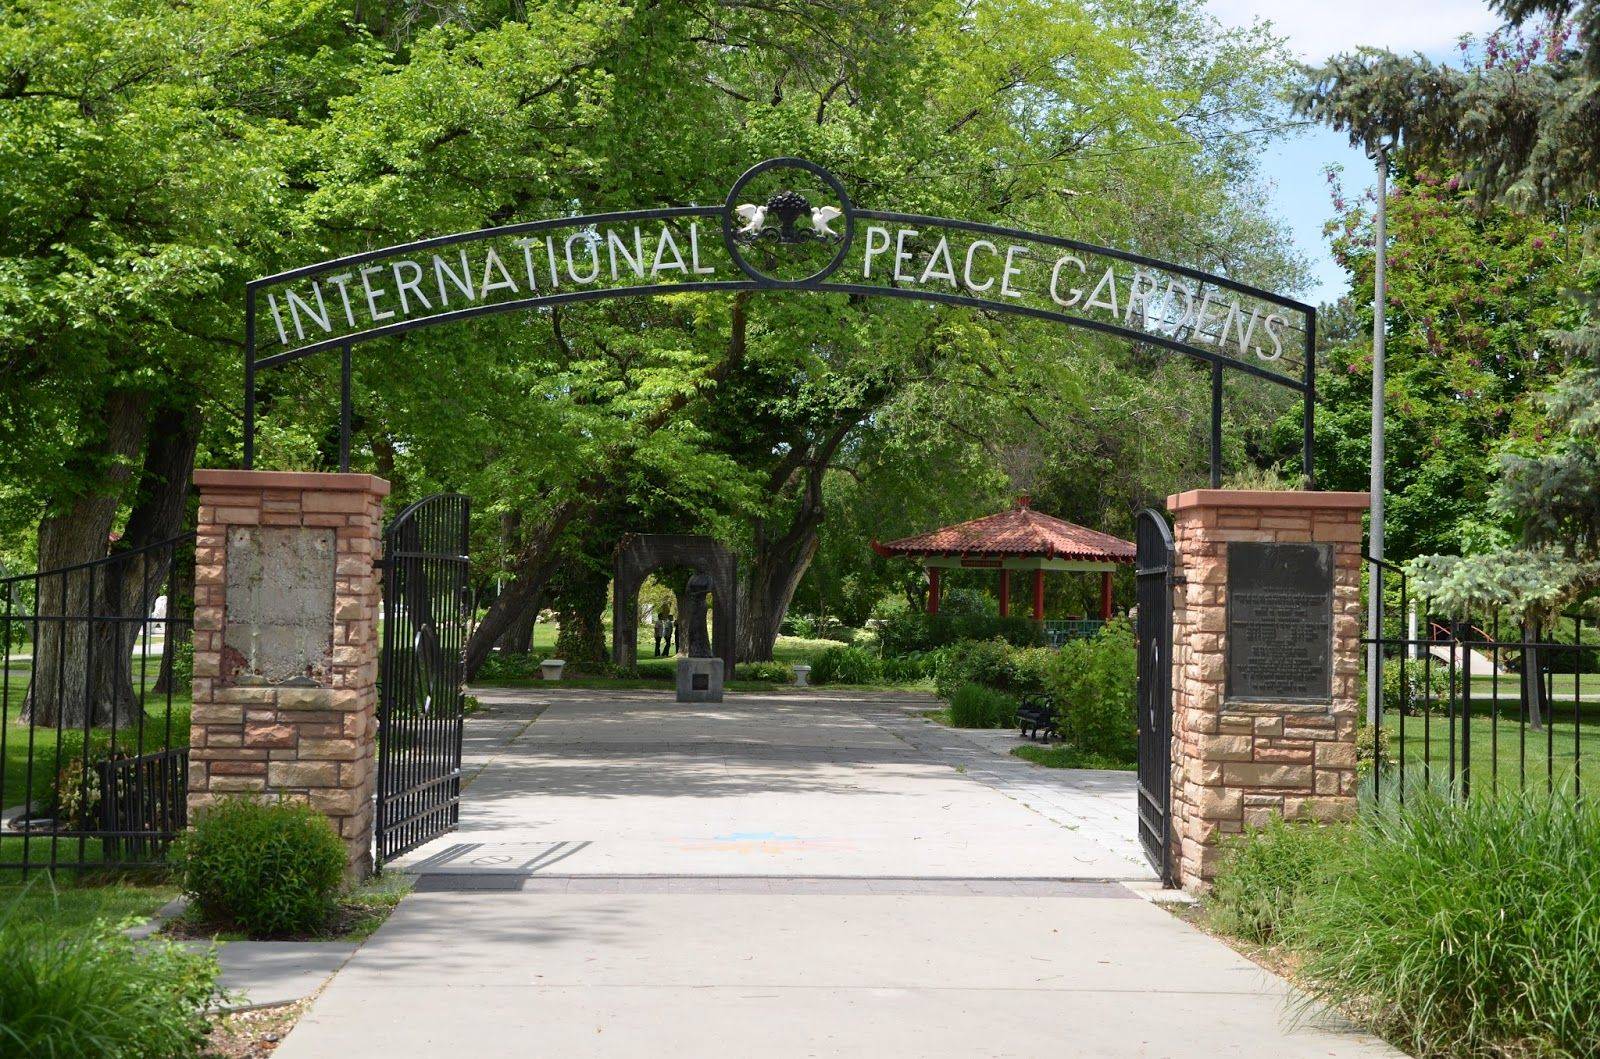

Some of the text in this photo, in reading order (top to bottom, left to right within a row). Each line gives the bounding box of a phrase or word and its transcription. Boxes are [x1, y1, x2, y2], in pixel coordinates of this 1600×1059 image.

[267, 222, 1289, 362] INTERNATIONAL PEACE GARDENS
